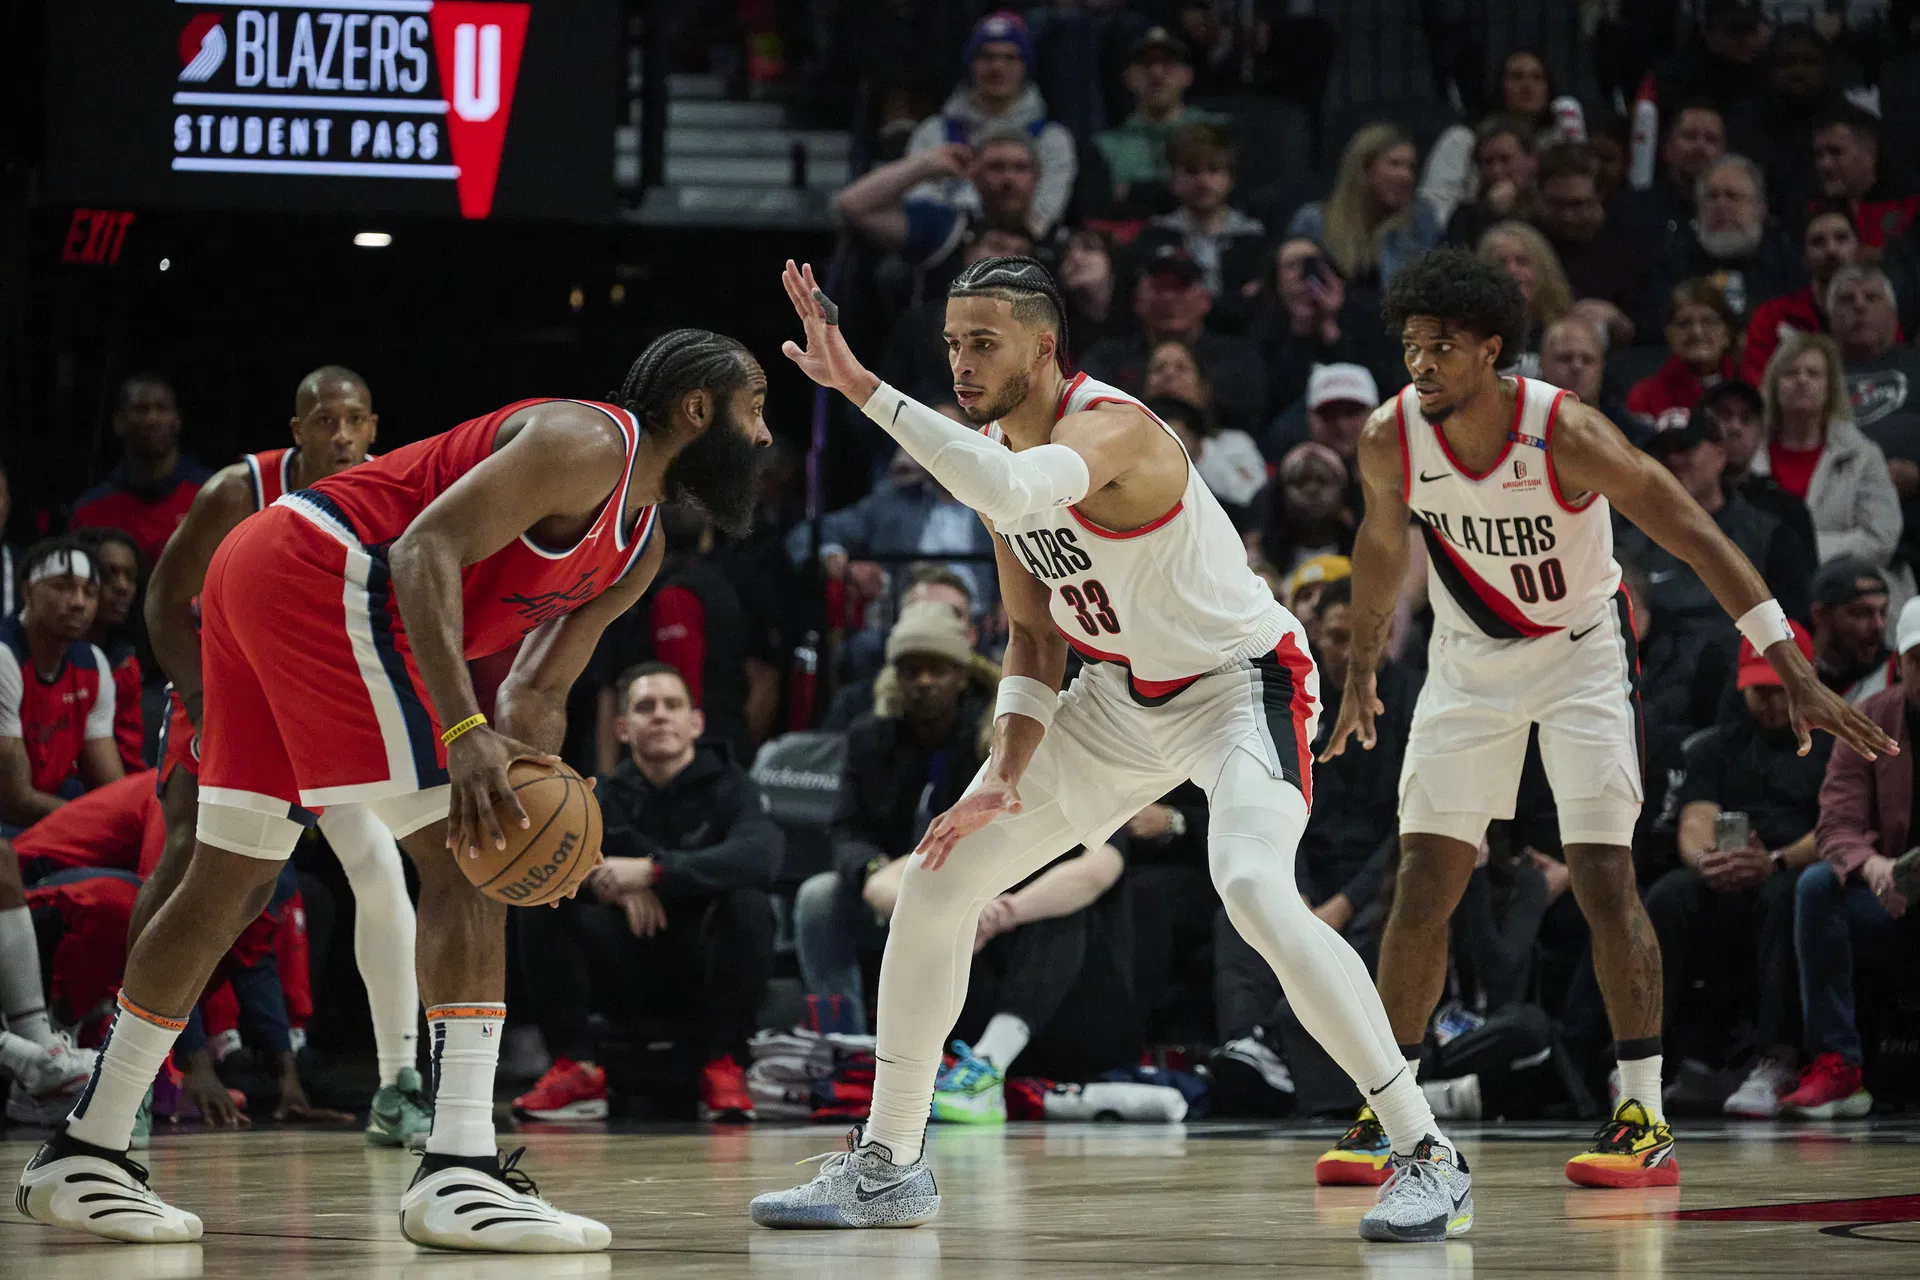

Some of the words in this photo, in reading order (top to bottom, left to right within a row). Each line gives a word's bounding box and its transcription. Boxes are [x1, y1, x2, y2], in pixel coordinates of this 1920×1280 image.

[236, 10, 429, 93] BLAZERS
[453, 23, 501, 122] U
[174, 114, 333, 157] STUDENT
[350, 119, 438, 160] PASS
[61, 208, 136, 264] EXIT
[1502, 479, 1542, 489] BRIGHTSIDE
[1059, 578, 1121, 637] 33
[1510, 557, 1567, 604] 00
[496, 831, 581, 900] Wilson
